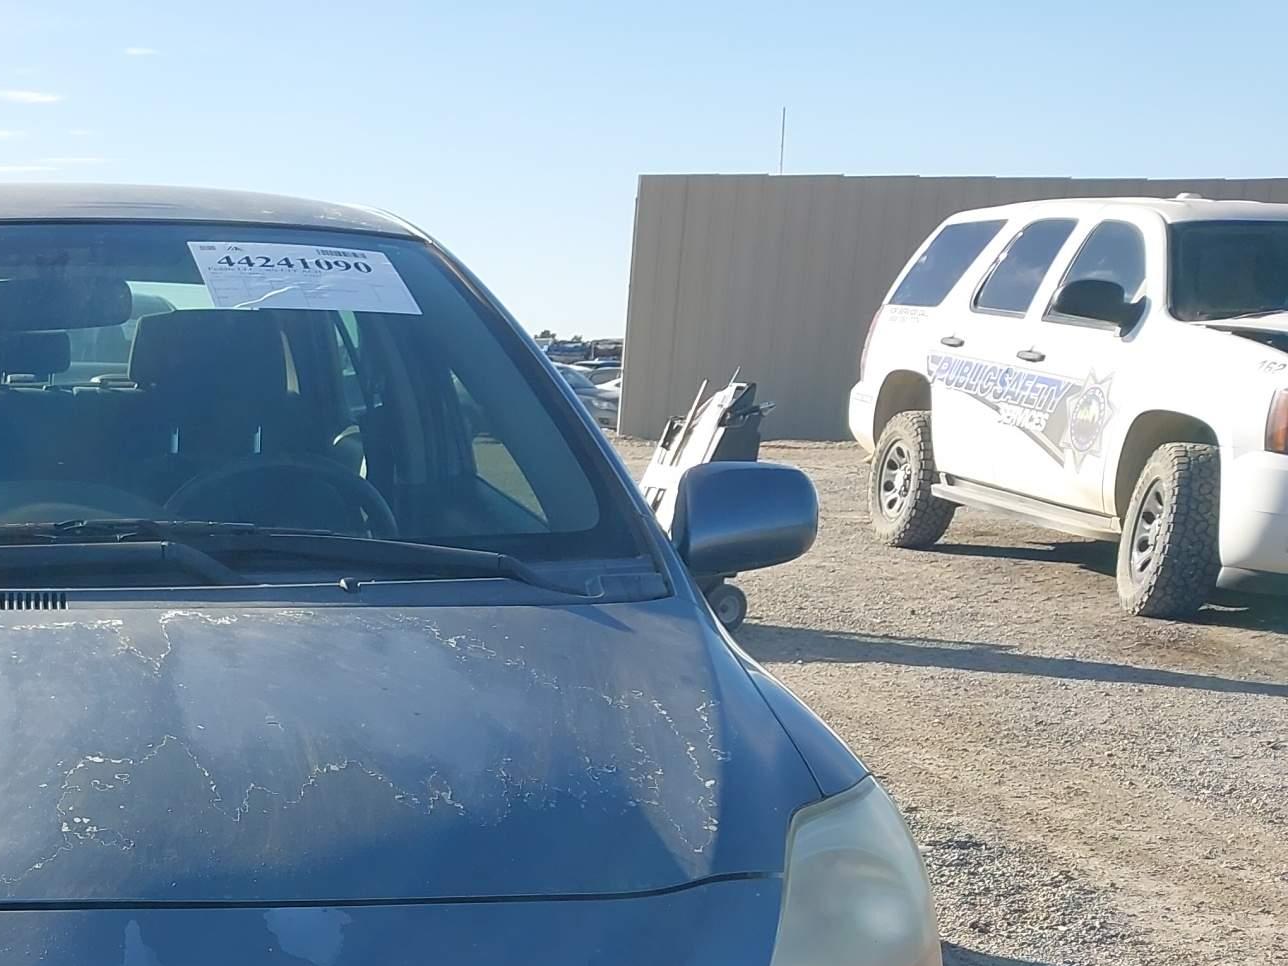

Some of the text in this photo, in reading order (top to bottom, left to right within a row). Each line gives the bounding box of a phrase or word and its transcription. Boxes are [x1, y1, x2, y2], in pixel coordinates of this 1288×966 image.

[217, 255, 373, 274] 44241090
[935, 355, 1071, 413] PUBLIC SAFETY
